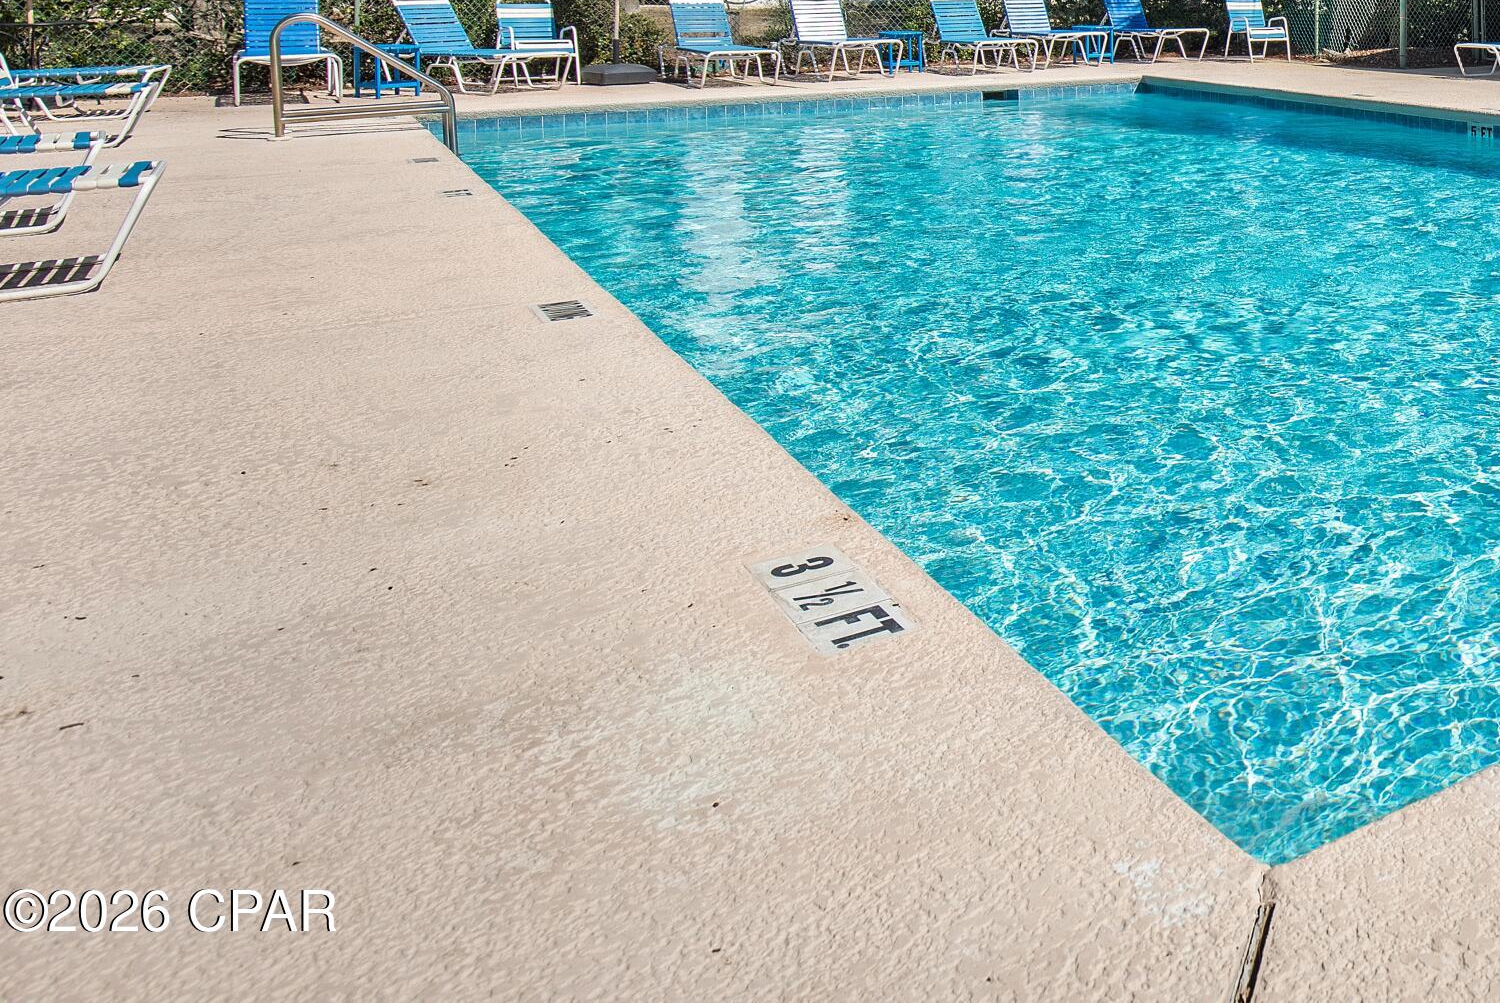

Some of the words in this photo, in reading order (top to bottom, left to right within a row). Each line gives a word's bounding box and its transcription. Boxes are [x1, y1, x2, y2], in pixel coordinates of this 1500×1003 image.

[1481, 127, 1492, 137] FT
[770, 556, 834, 577] 3
[814, 604, 905, 649] FT.
